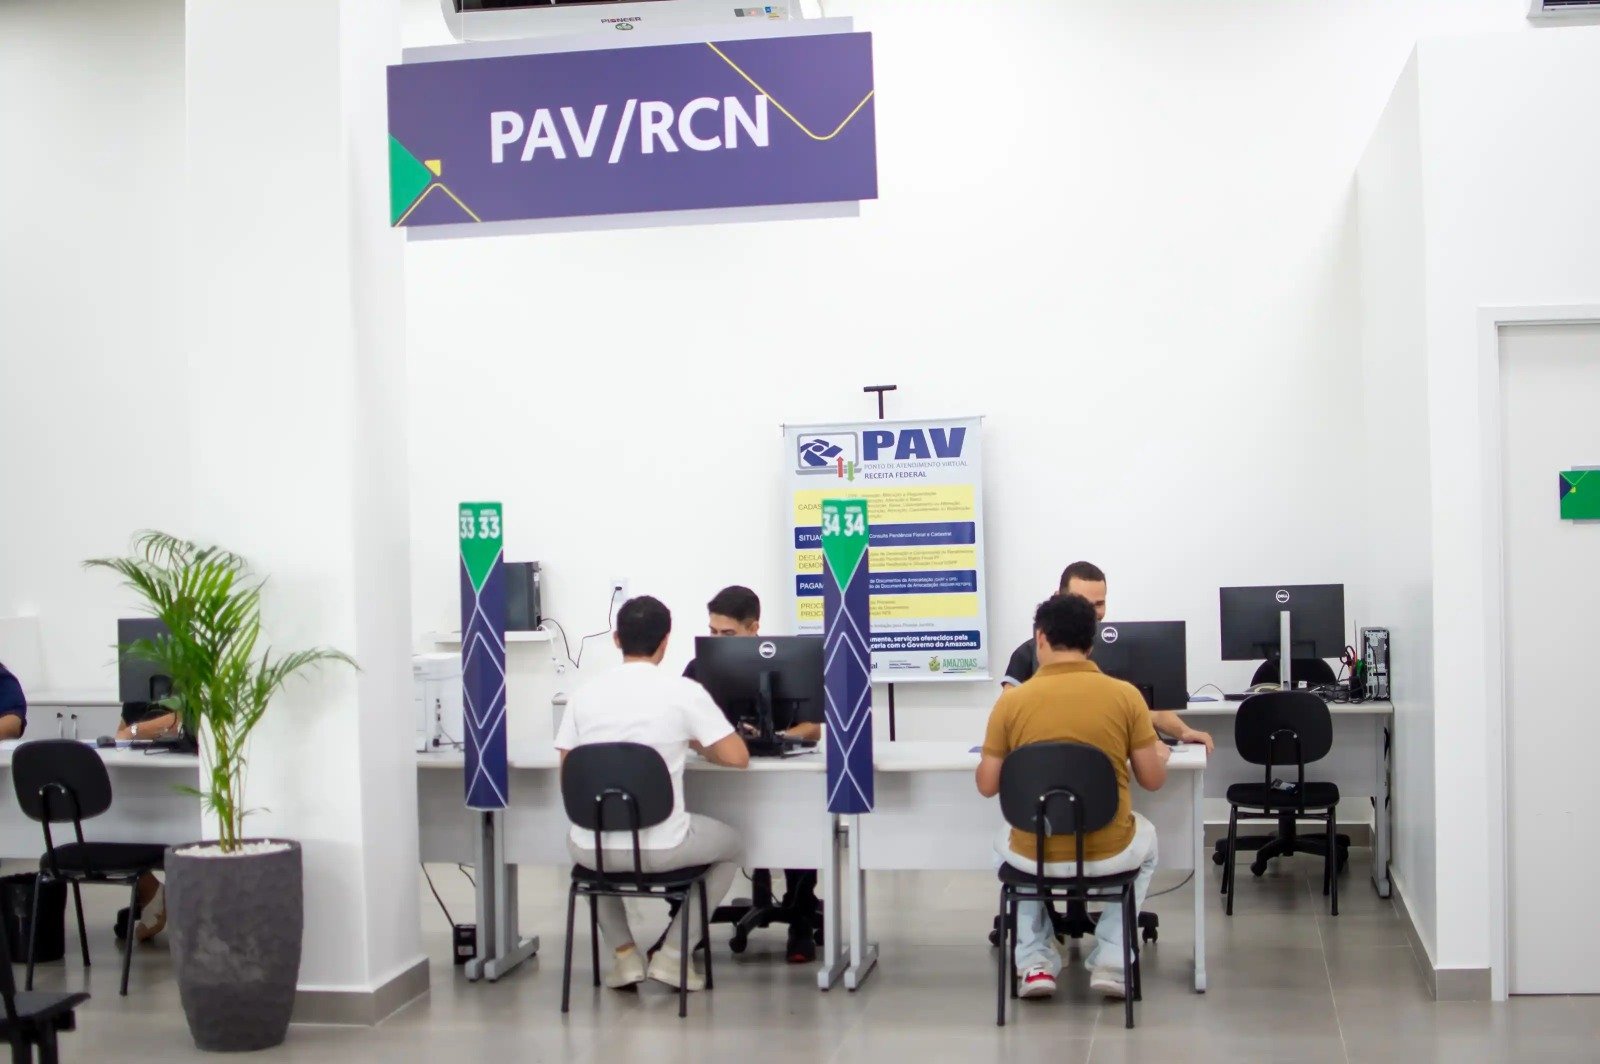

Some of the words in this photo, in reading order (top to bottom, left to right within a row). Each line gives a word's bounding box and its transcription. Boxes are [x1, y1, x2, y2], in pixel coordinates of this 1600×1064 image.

[490, 94, 769, 164] PAV/RCN
[862, 427, 966, 461] PAV
[896, 461, 940, 469] ATENDIMENTO
[942, 460, 968, 468] VIRTUAL
[864, 472, 894, 480] RECEITA
[895, 470, 927, 479] FEDERAL
[798, 503, 822, 511] CADAS
[460, 516, 475, 539] 33
[478, 516, 500, 539] 33
[822, 512, 841, 537] 34
[843, 512, 866, 537] 34
[798, 554, 823, 562] DECLA
[894, 634, 920, 643] serviços
[921, 633, 954, 642] oferecidos
[955, 633, 969, 642] pela
[907, 640, 935, 648] Governo
[935, 640, 944, 648] do
[945, 639, 977, 647] Amazonas
[943, 658, 978, 669] AMAZONAS
